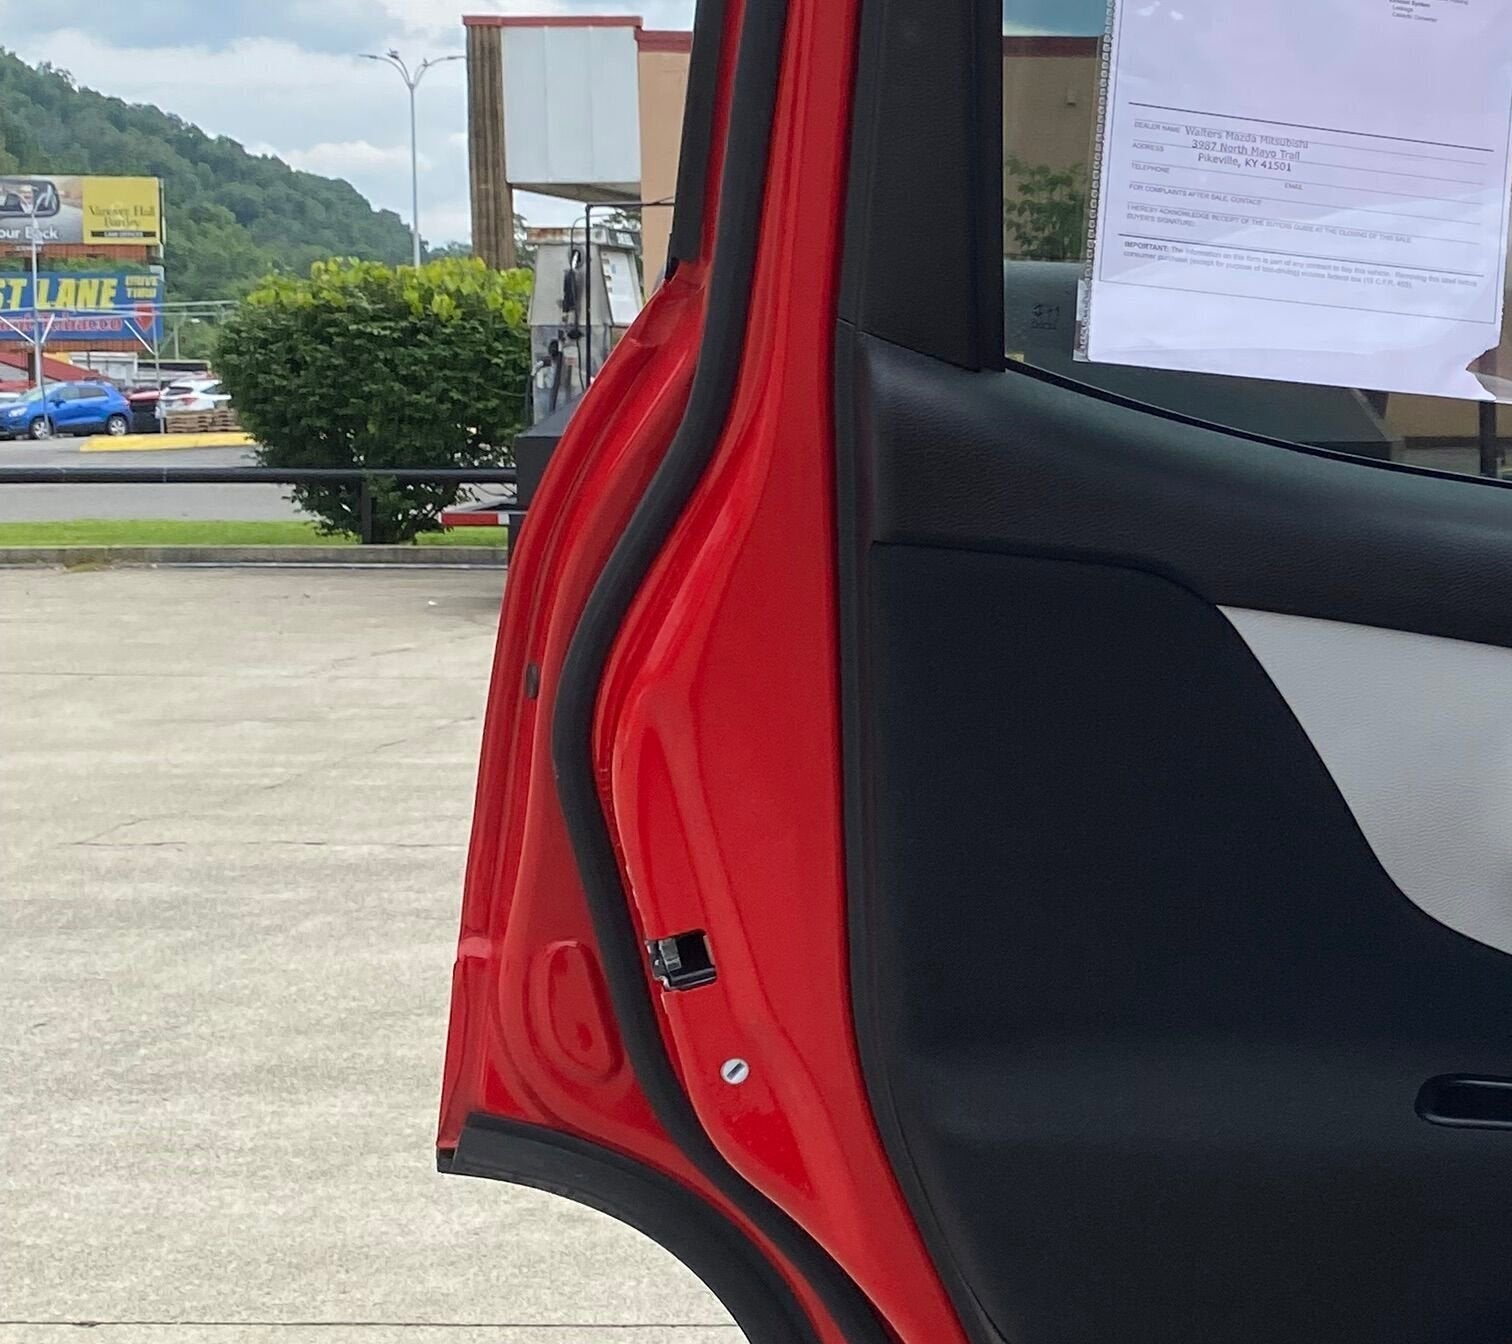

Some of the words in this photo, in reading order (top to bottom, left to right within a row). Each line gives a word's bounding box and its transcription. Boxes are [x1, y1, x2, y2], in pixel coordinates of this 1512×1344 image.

[1184, 125, 1222, 139] Walters
[1224, 130, 1257, 144] Mazda
[1259, 135, 1308, 150] Mitsubishi
[1192, 138, 1217, 150] 3987
[1219, 142, 1248, 154] North
[1249, 145, 1277, 159] Mayo
[1279, 149, 1300, 160] Trail
[1131, 163, 1169, 173] TELEPHONE
[1197, 152, 1241, 168] Pikeville,
[1243, 158, 1259, 168] KY
[1260, 160, 1291, 172] 41501
[1144, 185, 1187, 195] COMPLAINTS
[1250, 218, 1264, 227] THE
[36, 277, 118, 311] LANE
